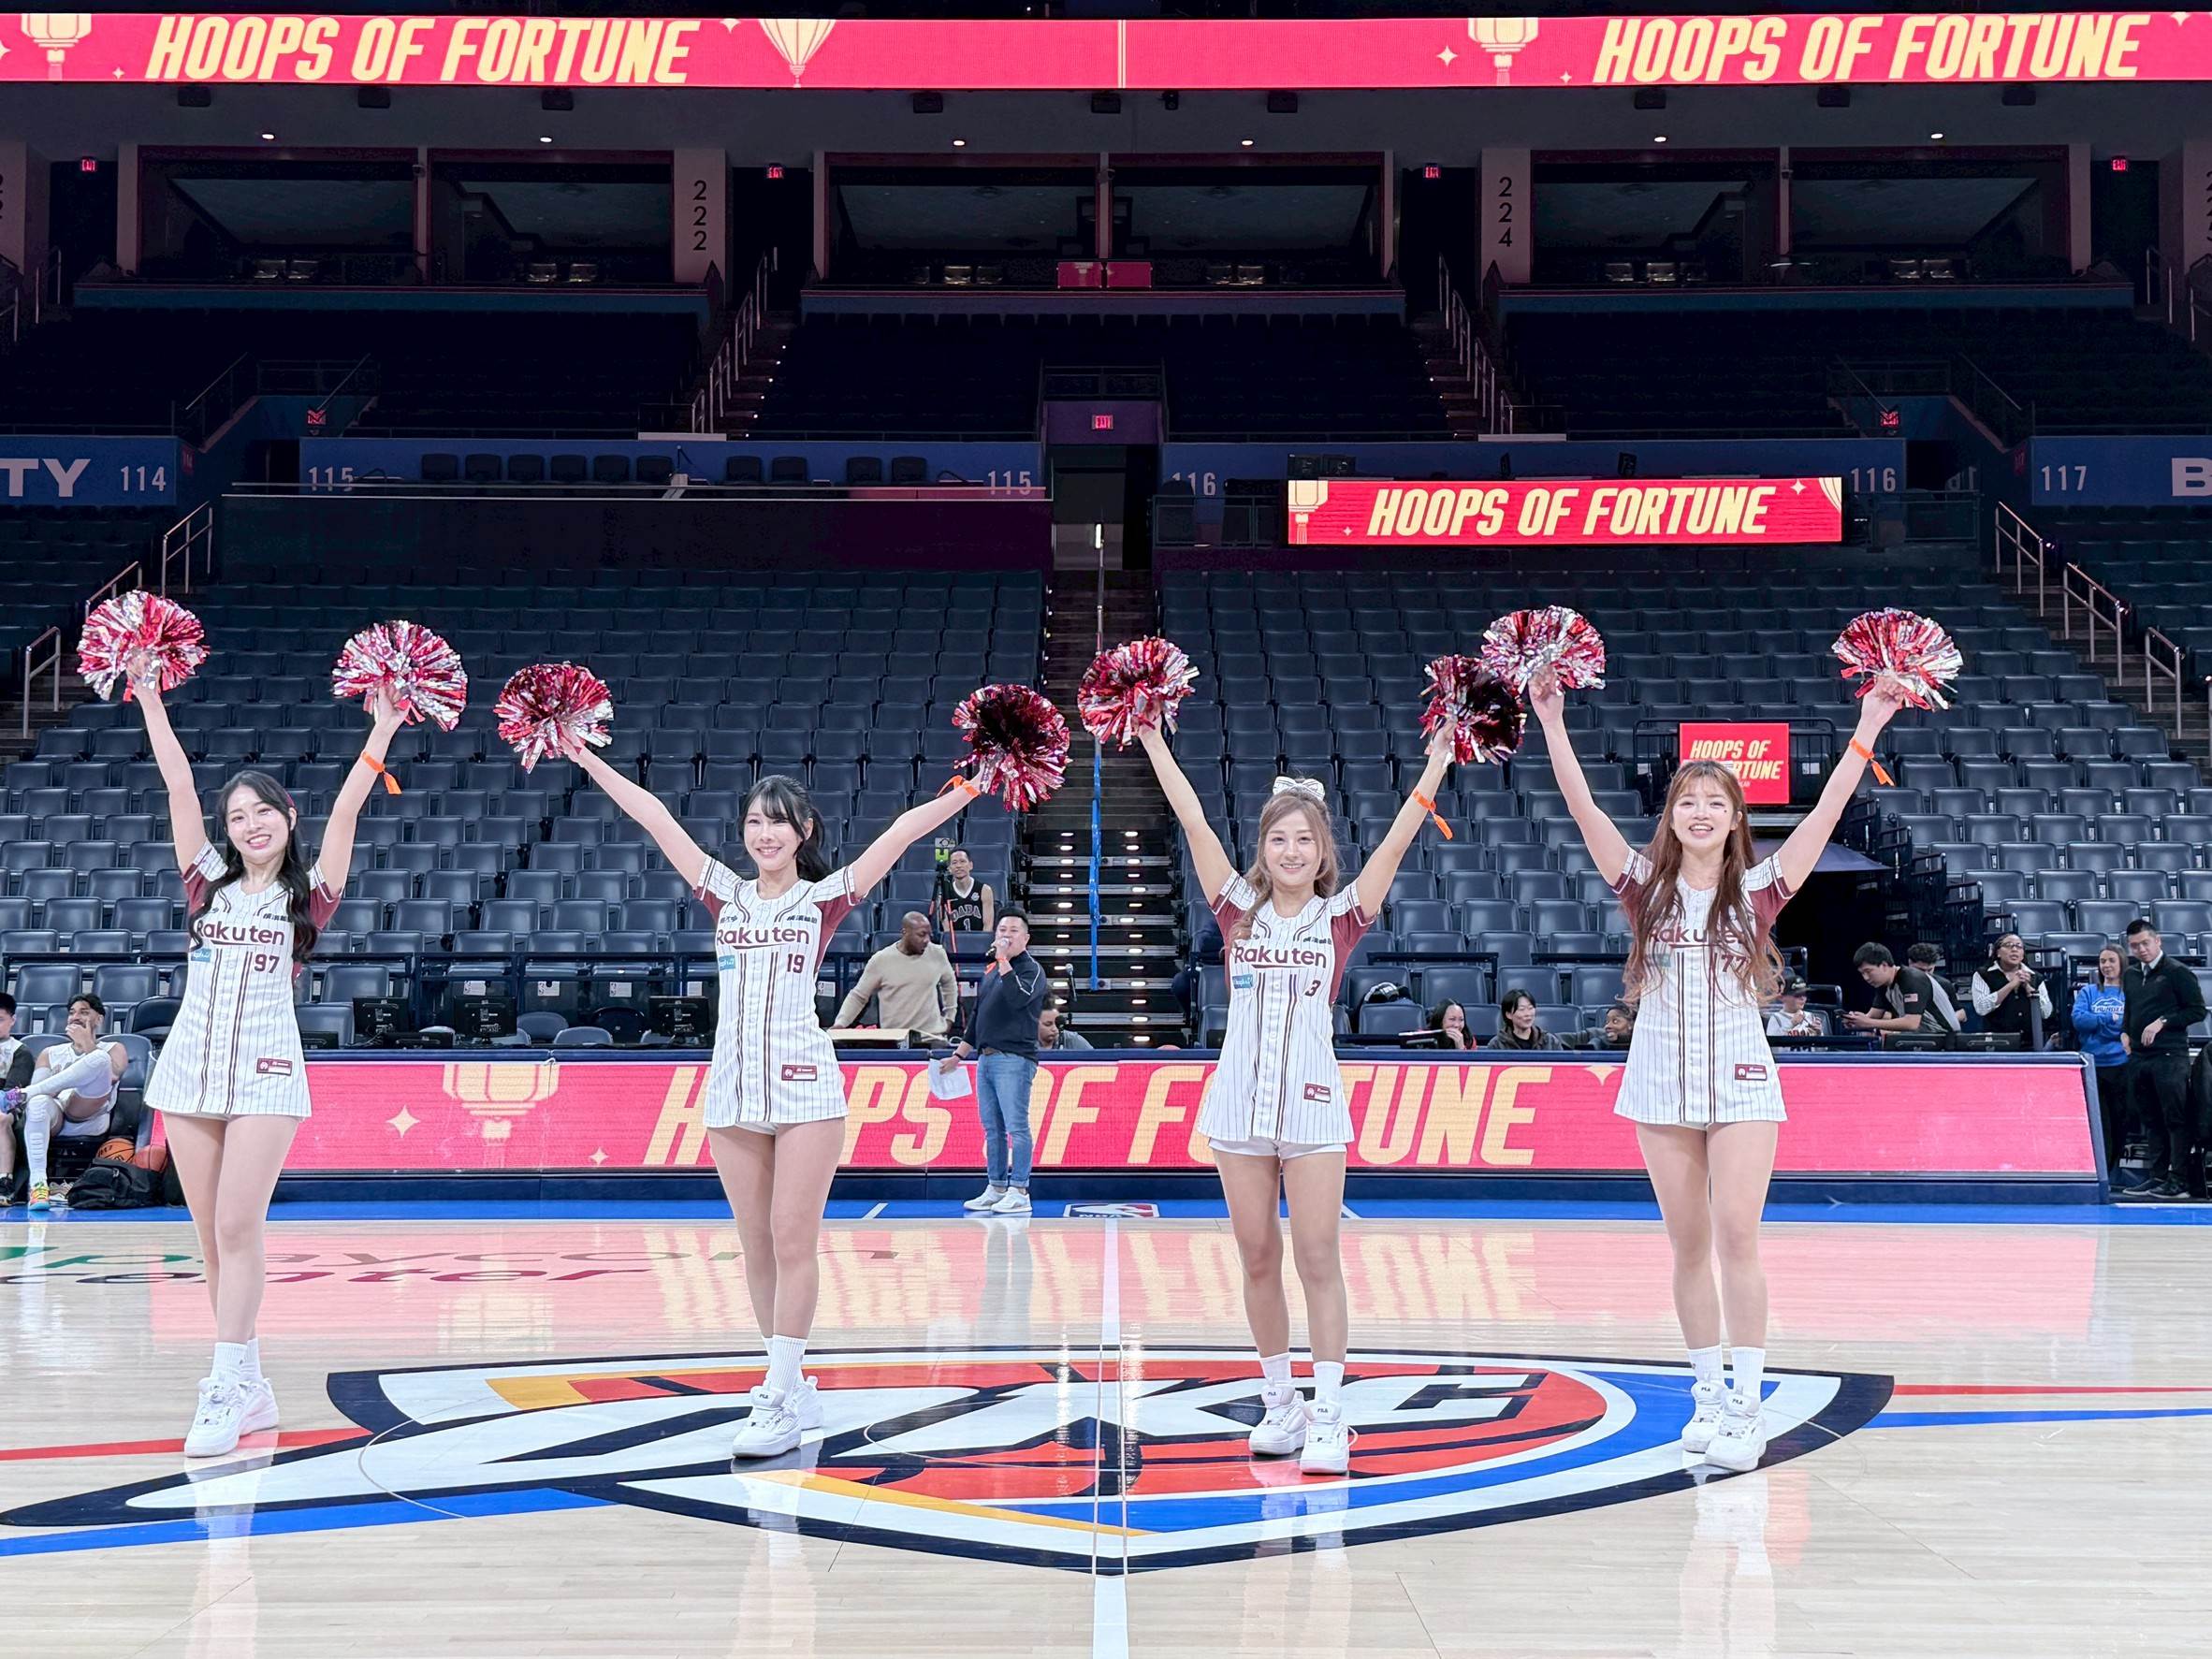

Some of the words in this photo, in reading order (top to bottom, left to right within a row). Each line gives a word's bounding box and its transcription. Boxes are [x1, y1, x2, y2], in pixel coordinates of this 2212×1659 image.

[145, 16, 337, 81] HOOPS
[352, 17, 435, 82] OF
[440, 19, 701, 83] FORTUNE
[1592, 17, 1787, 83] HOOPS
[1799, 16, 1885, 81] OF
[1888, 14, 2150, 80] FORTUNE
[692, 180, 707, 251] 222
[1497, 176, 1513, 248] 224
[0, 458, 91, 498] TY
[121, 466, 167, 492] 114
[309, 466, 355, 492] 115
[987, 470, 1032, 496] 115
[1851, 467, 1897, 493] 116
[2041, 465, 2088, 492] 117
[1366, 488, 1509, 537] HOOPS
[1517, 488, 1579, 536] OF
[1582, 486, 1776, 535] FORTUNE
[1689, 738, 1745, 761] HOOPS
[1747, 738, 1772, 760] OF
[196, 919, 284, 946] Rakuten
[717, 926, 810, 946] Rakuten
[254, 953, 280, 974] 97
[787, 953, 805, 974] 19
[1233, 945, 1327, 969] Rakuten
[1304, 980, 1321, 997] 3
[643, 1065, 953, 1166] HPS
